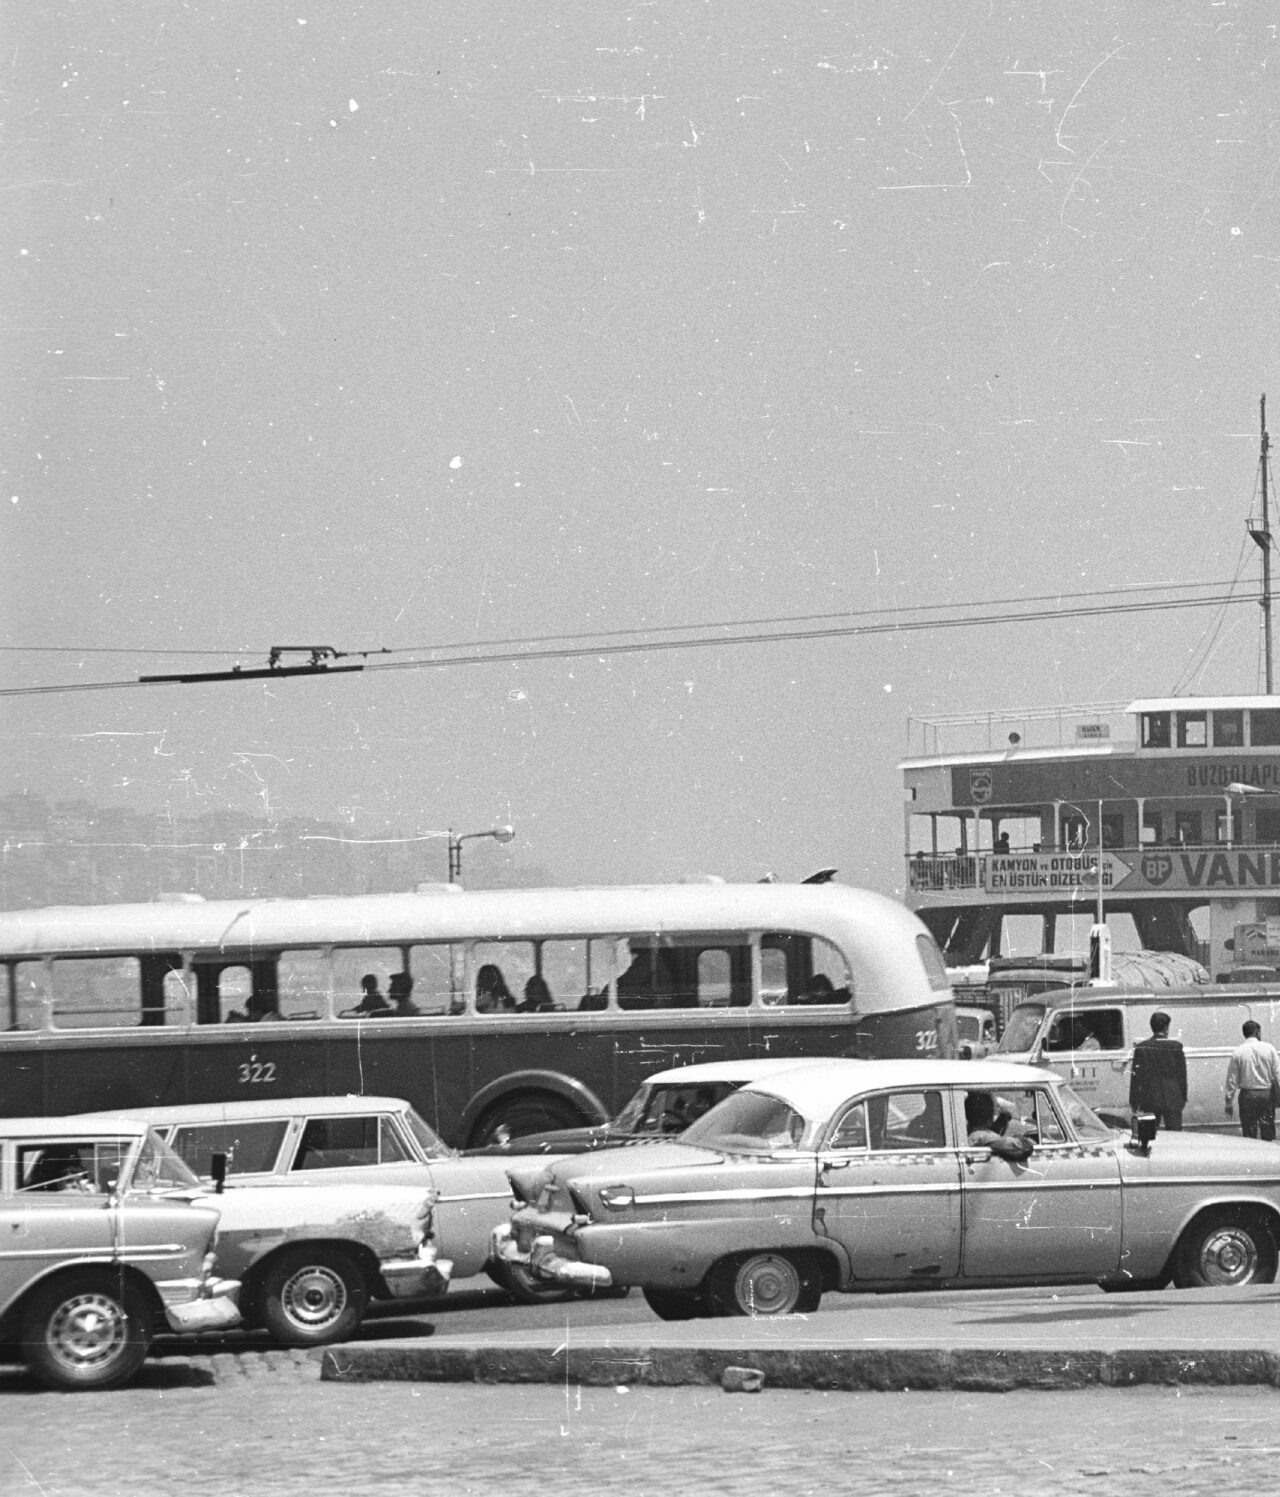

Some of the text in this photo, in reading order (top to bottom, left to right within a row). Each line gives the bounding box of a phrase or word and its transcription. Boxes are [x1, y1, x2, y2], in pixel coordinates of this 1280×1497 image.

[991, 858, 1037, 871] KAMYON
[1051, 854, 1098, 871] OTOBÜS
[1146, 860, 1169, 878] BP
[991, 874, 1006, 888] EN
[1009, 872, 1048, 888] ÜSTÜN
[915, 1028, 938, 1051] 322
[238, 1062, 277, 1084] 322
